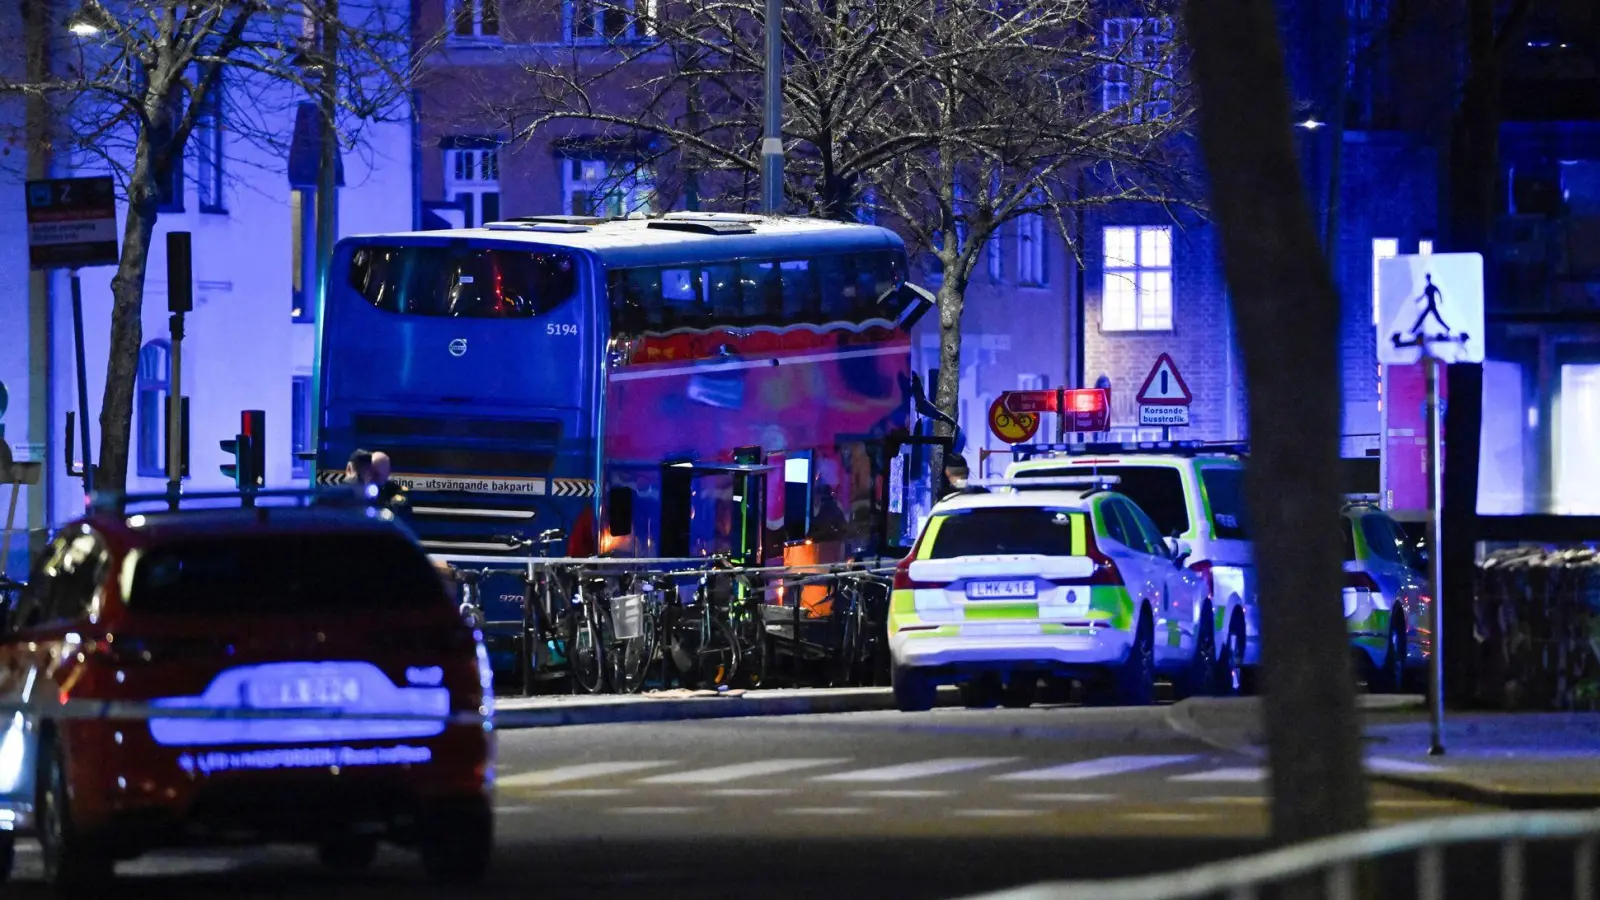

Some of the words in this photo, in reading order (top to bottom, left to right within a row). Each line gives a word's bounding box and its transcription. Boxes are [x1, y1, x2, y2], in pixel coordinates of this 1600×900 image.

[546, 323, 578, 336] 5194
[1143, 415, 1185, 423] busstrafik
[425, 479, 489, 491] utsvängande
[491, 481, 535, 492] bakparti
[977, 582, 1001, 595] LMK
[1004, 580, 1029, 593] 41E
